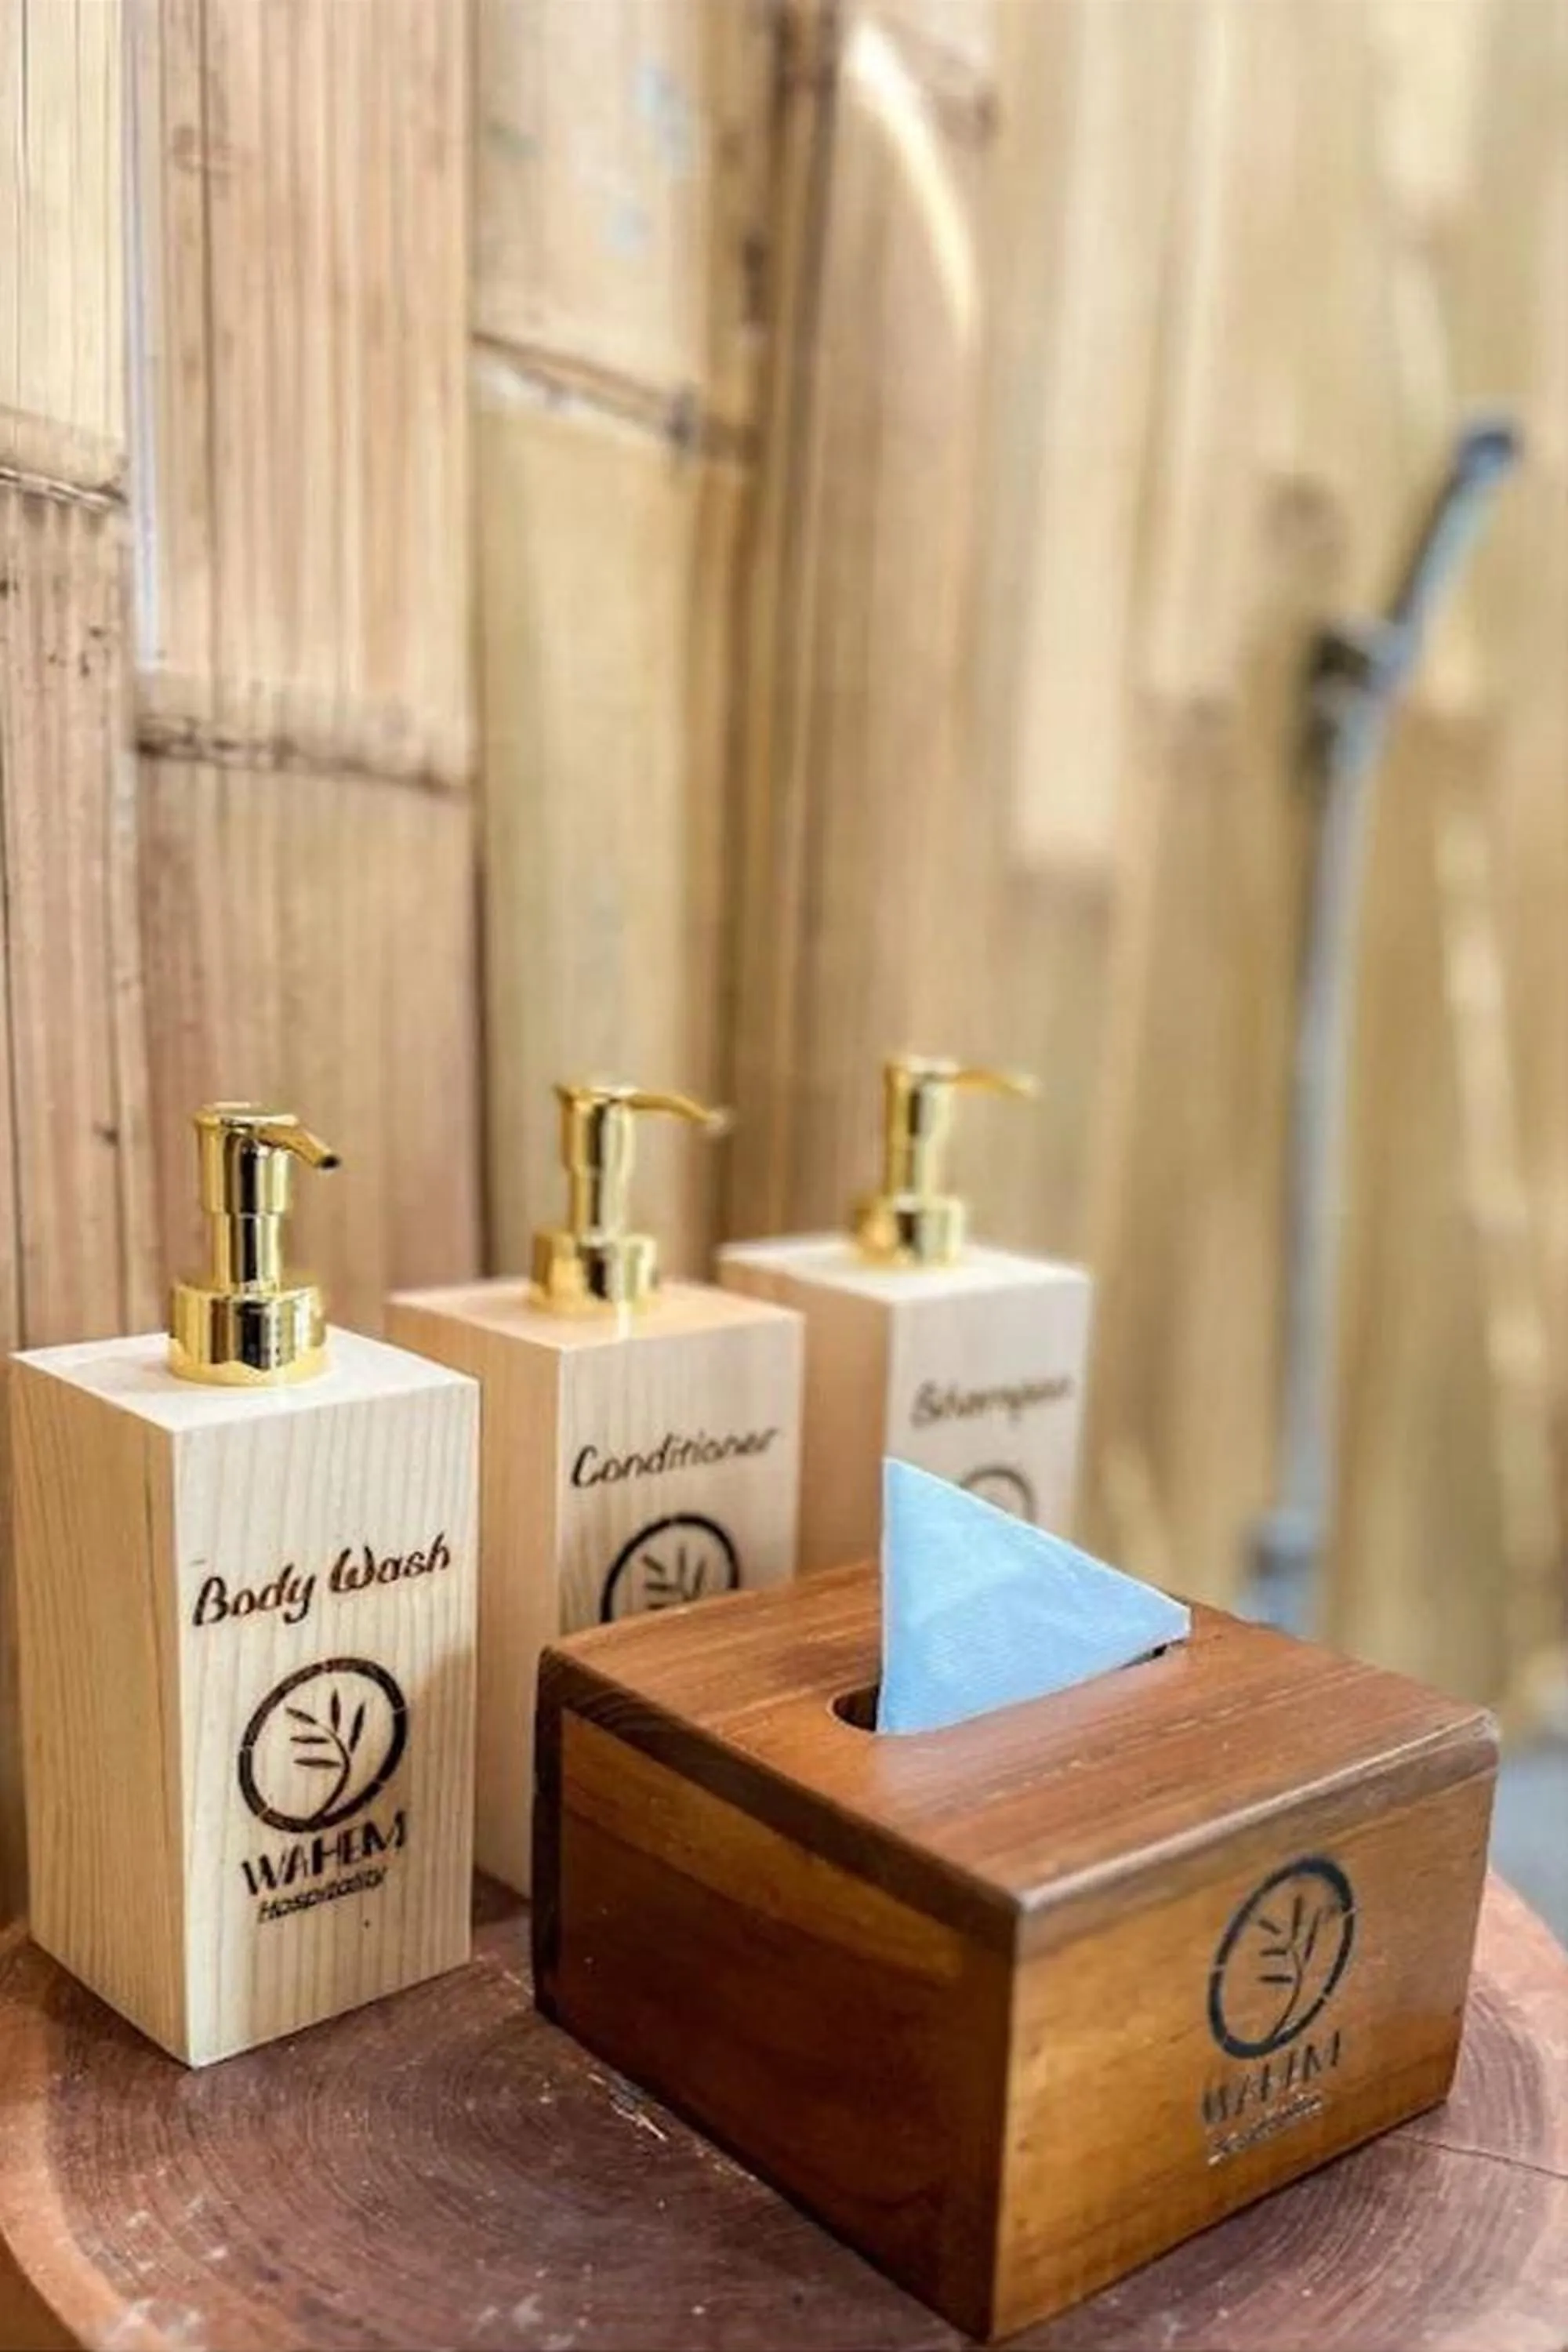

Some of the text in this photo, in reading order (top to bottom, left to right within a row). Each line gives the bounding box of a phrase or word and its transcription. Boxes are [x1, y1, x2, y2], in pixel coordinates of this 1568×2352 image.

[571, 1428, 779, 1487] Conditioner
[192, 1531, 451, 1626] Body Wash
